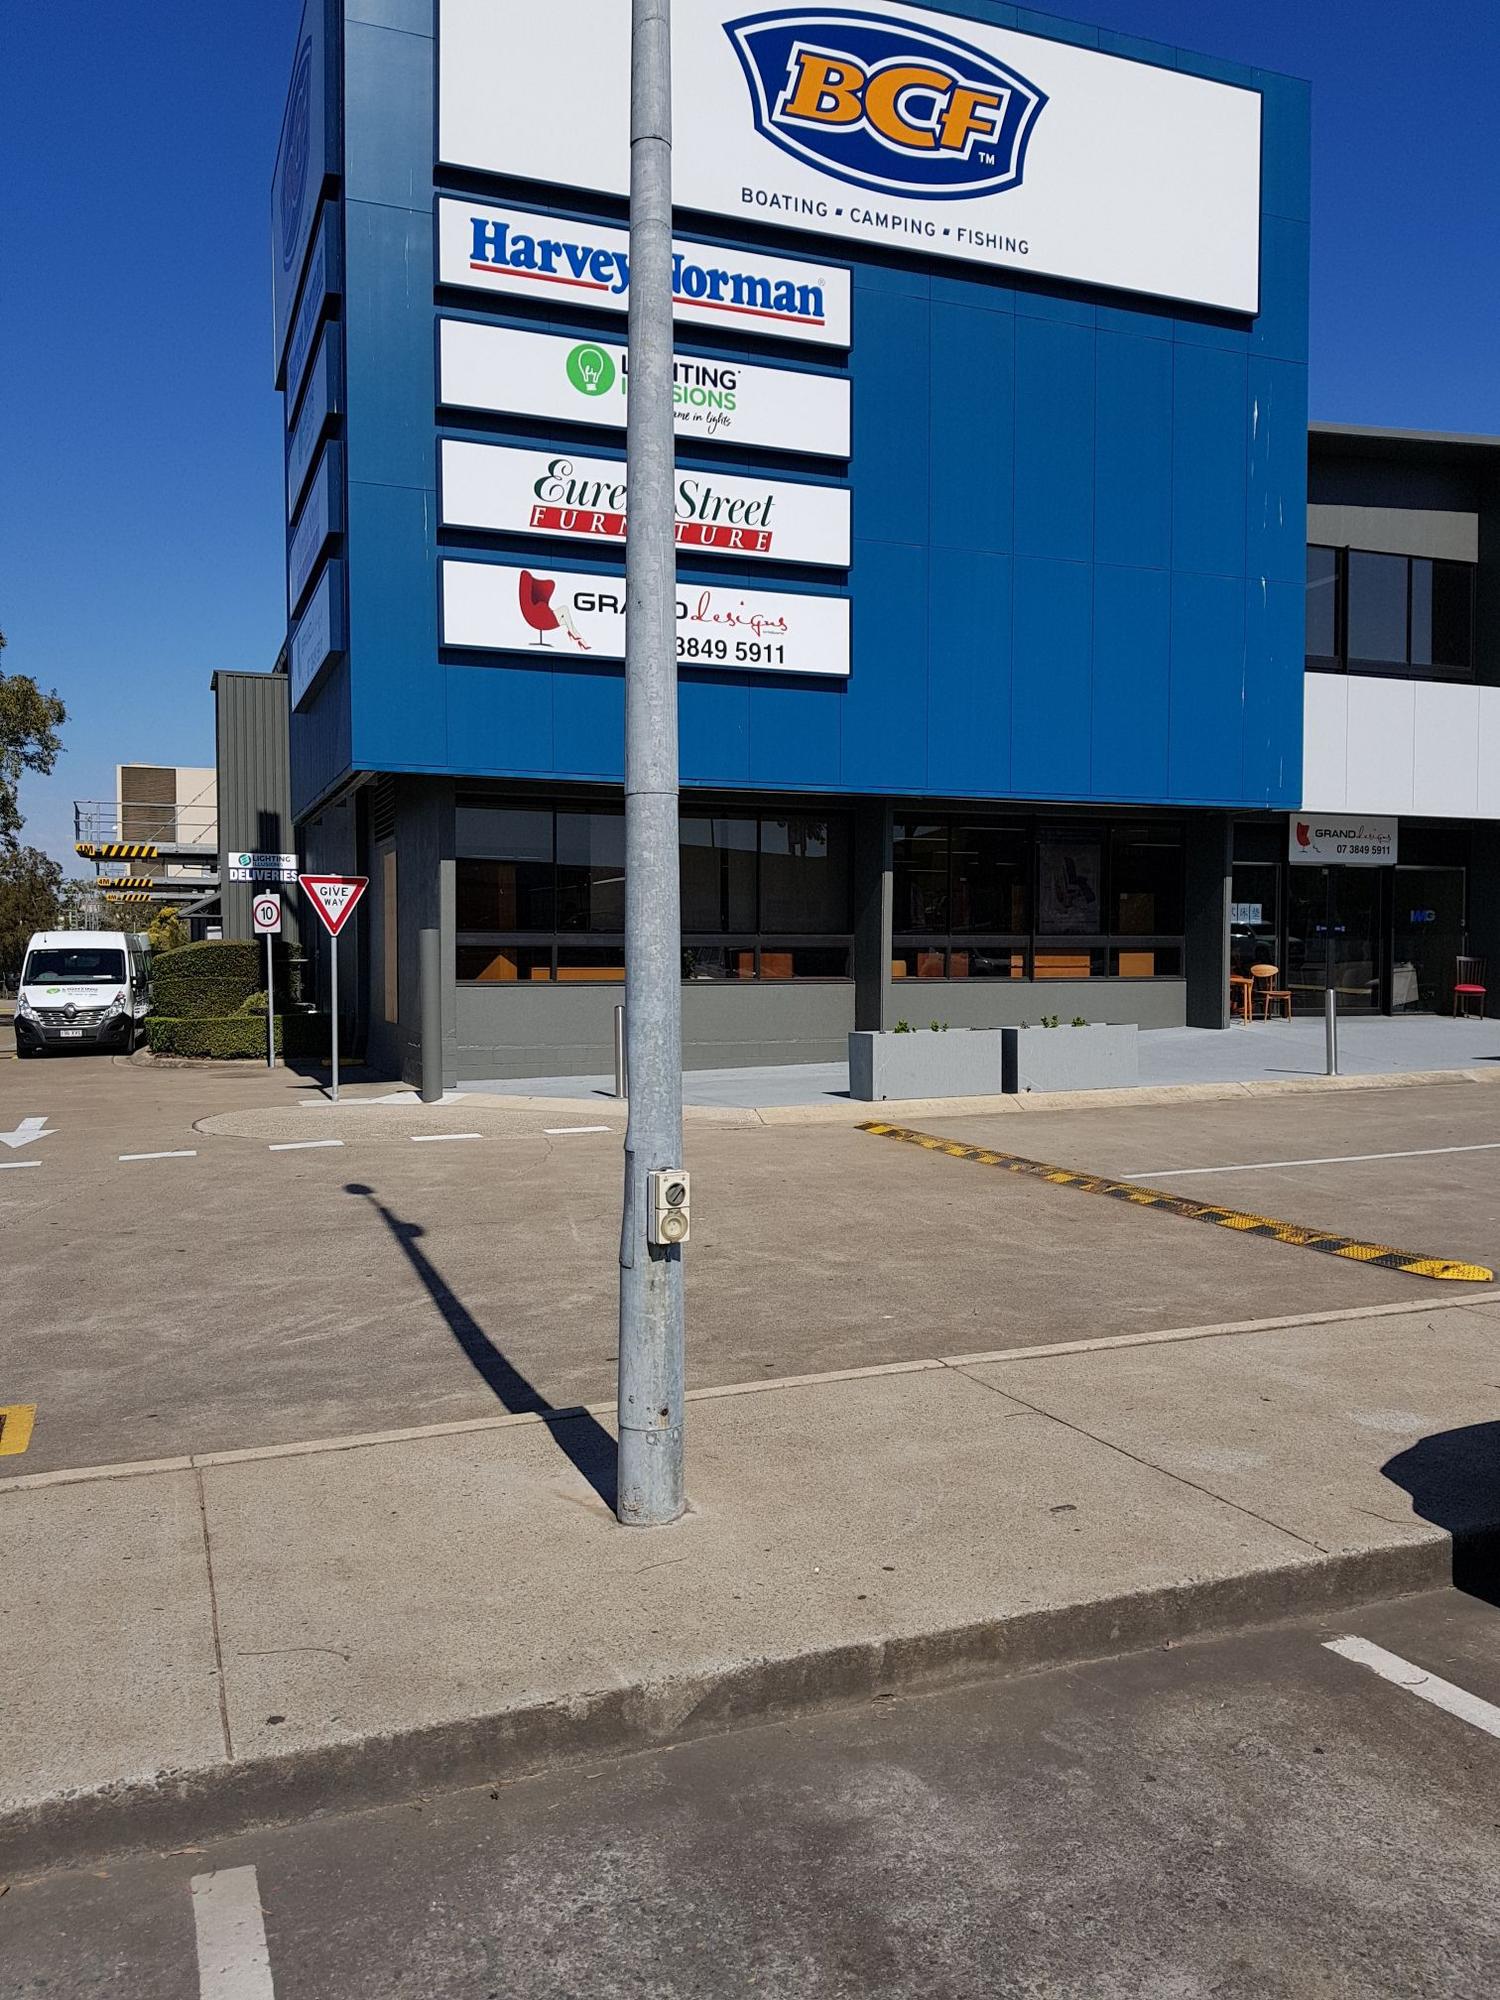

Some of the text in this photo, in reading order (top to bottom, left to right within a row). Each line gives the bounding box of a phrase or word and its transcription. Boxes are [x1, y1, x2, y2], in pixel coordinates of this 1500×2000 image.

[783, 51, 1002, 151] BCF
[978, 151, 995, 166] TM
[741, 186, 1030, 255] BOATING CAMPING FISHING
[621, 354, 737, 391] LTING
[533, 458, 776, 527] Eure Street
[531, 506, 769, 550] FURTURE
[690, 590, 788, 637] designs
[735, 641, 785, 664] 5911
[1315, 829, 1356, 839] GRAND
[252, 854, 291, 864] LIGHTING
[1336, 844, 1347, 854] 07
[1371, 845, 1390, 855] 5911
[229, 868, 298, 882] DELIVERIES
[320, 886, 349, 897] GIVE
[260, 906, 274, 920] 10
